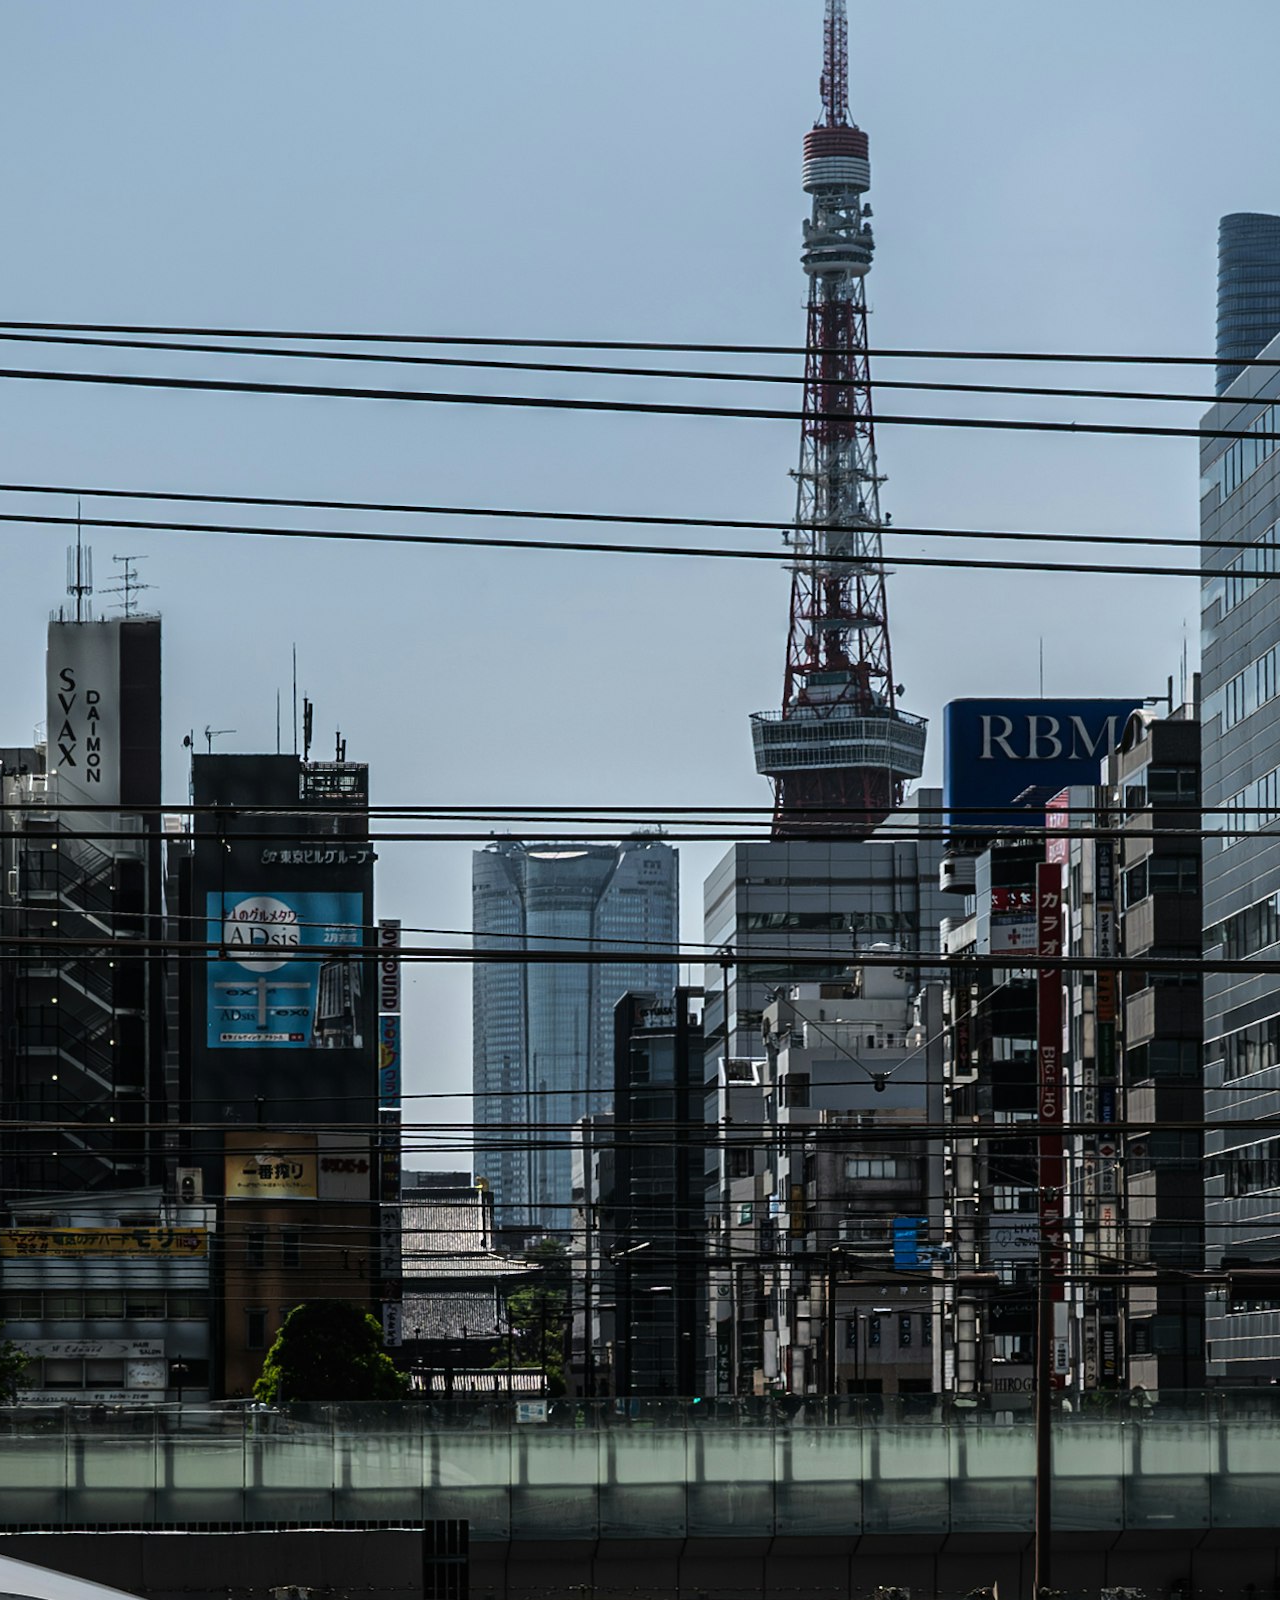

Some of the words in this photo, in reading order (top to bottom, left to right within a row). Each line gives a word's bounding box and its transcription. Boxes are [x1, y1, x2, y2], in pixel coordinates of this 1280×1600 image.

[57, 667, 77, 768] SVAX
[86, 689, 101, 783] DAIMON
[1041, 1045, 1056, 1074] BIG
[242, 1163, 304, 1180] 一番搾り
